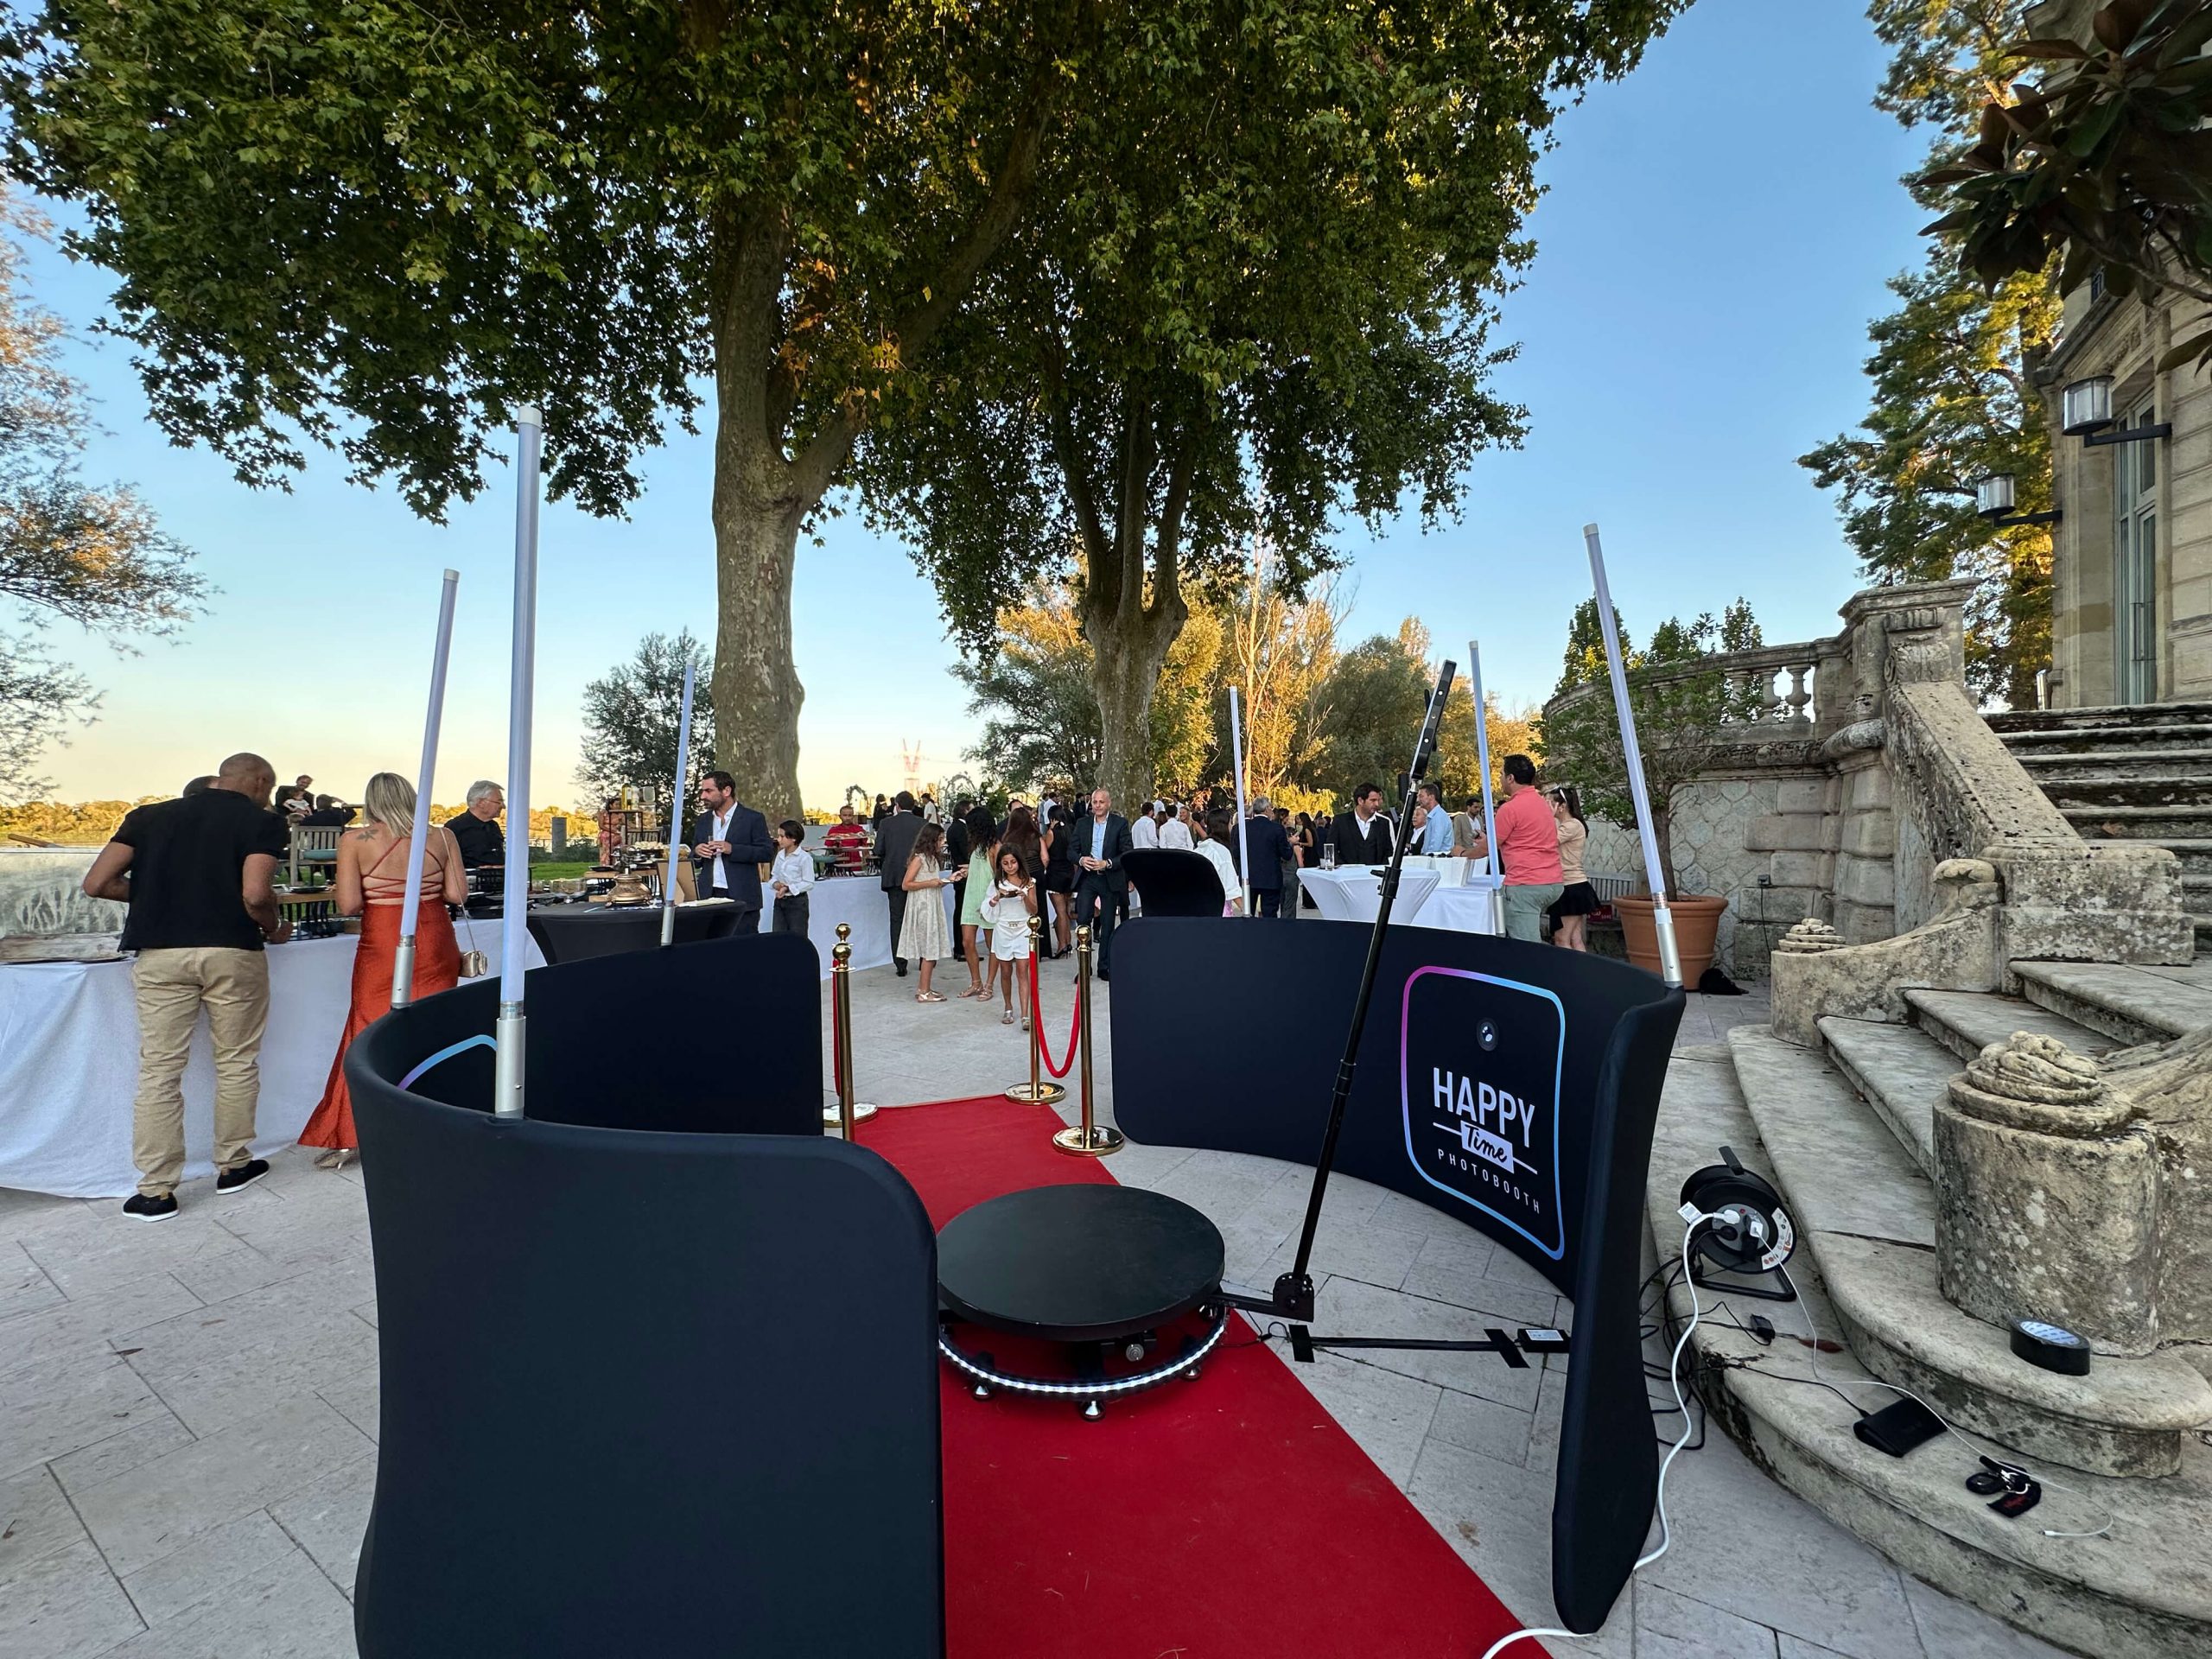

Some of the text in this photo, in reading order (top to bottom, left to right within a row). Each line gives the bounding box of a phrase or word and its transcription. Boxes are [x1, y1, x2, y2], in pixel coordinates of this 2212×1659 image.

[1433, 1067, 1535, 1147] HAPPY
[1465, 1125, 1508, 1162] Time
[1438, 1148, 1540, 1214] PHOTOBOOTH
